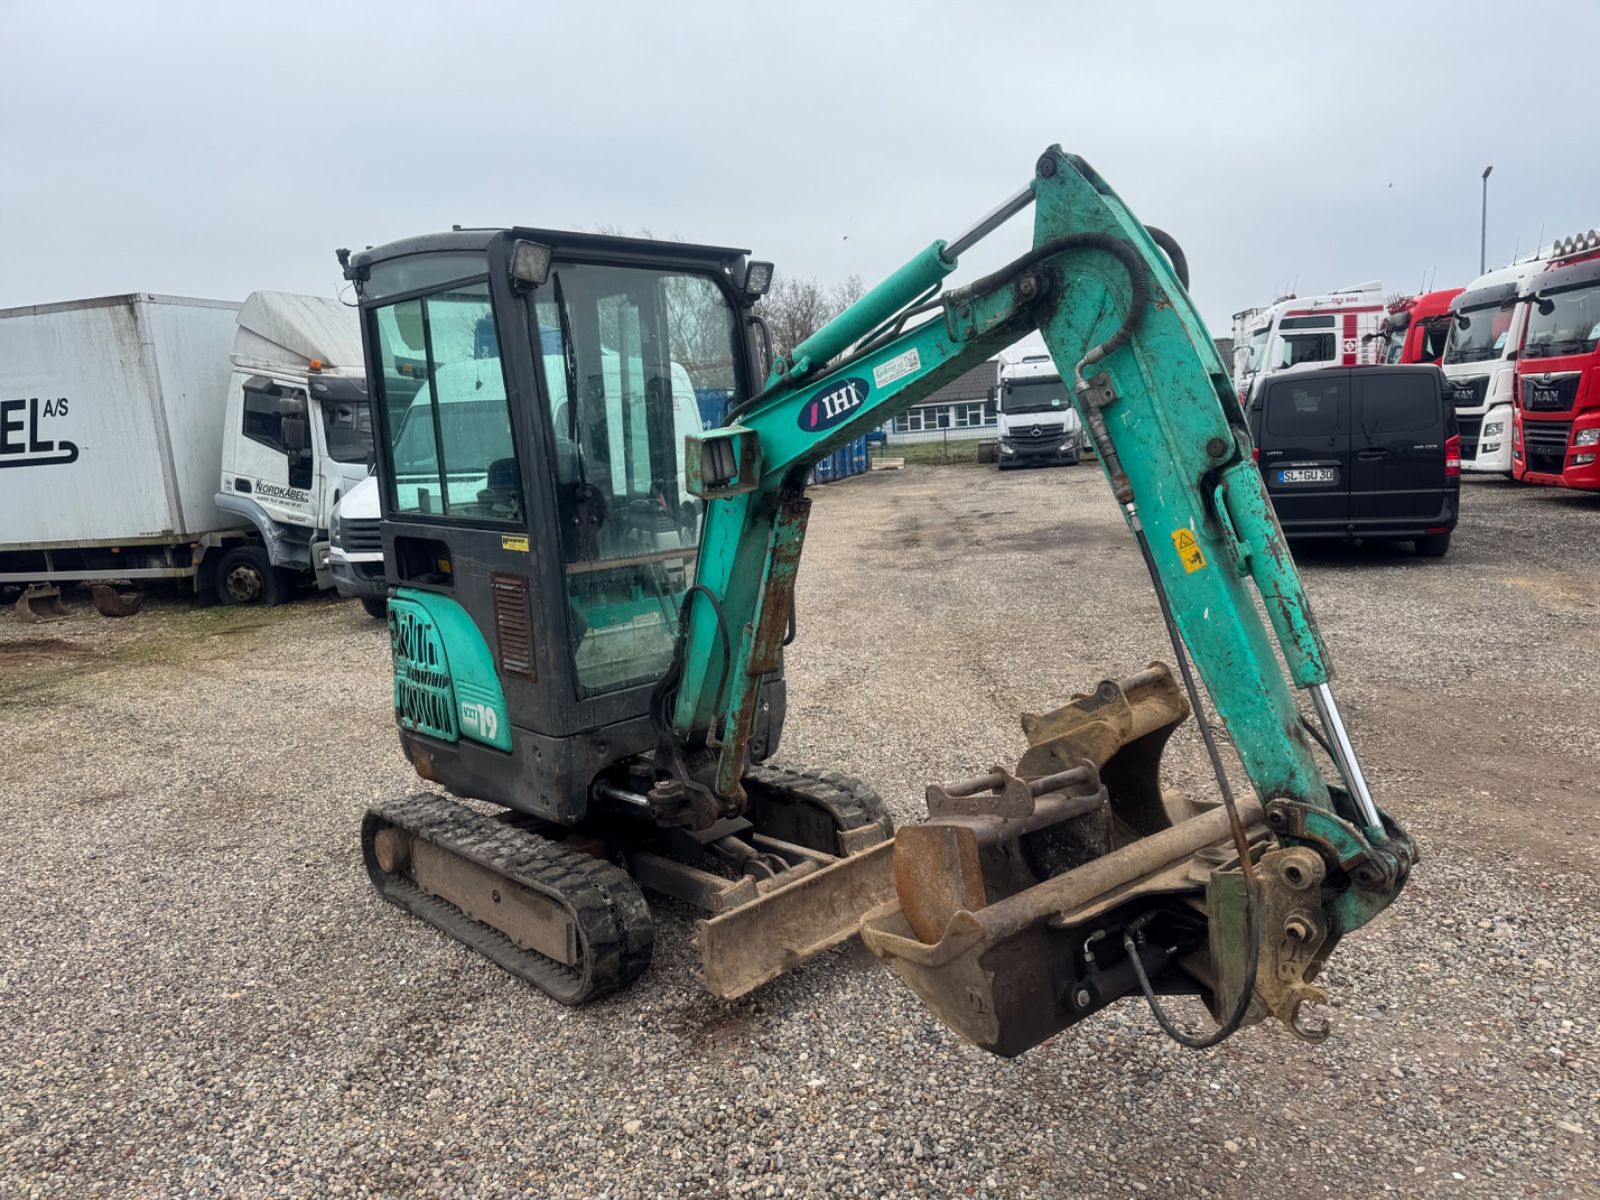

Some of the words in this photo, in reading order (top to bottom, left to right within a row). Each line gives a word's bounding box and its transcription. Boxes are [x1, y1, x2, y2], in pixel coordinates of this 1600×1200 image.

[822, 382, 860, 419] IHI
[1534, 390, 1559, 401] MAN
[43, 397, 68, 417] A/S
[1284, 470, 1297, 481] SL
[1304, 470, 1318, 480] GU
[1320, 469, 1333, 480] 30
[477, 703, 497, 740] 19
